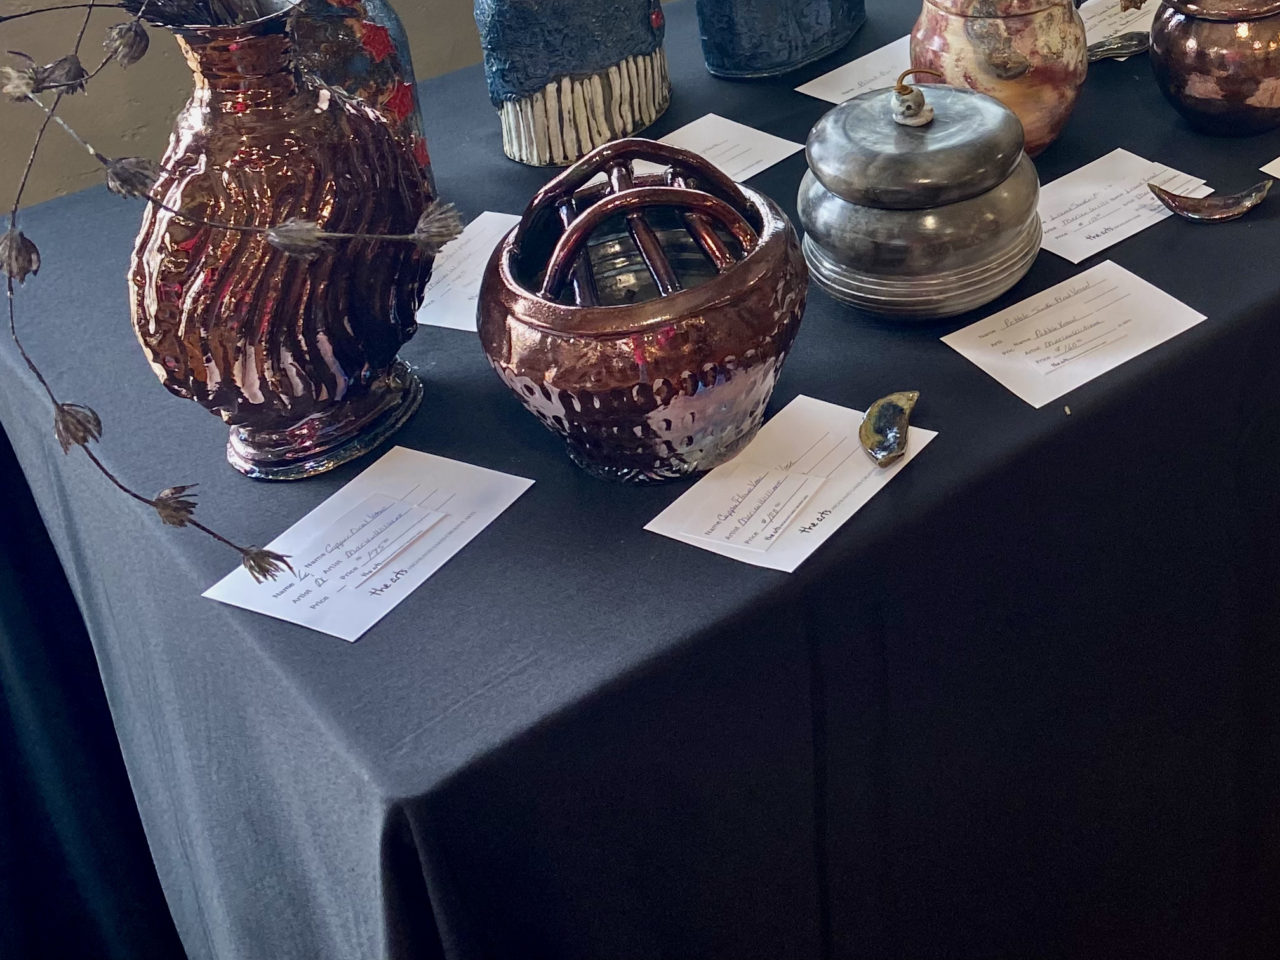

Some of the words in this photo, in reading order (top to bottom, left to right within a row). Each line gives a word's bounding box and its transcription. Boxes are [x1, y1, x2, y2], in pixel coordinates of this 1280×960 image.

[799, 522, 818, 534] the
[818, 509, 832, 522] arts
[305, 554, 325, 568] Name
[323, 560, 341, 574] Artist
[341, 566, 358, 580] Price
[369, 582, 391, 597] the
[391, 568, 409, 584] arts
[272, 583, 294, 598] Name
[292, 589, 312, 604] Artist
[310, 596, 329, 609] Price
